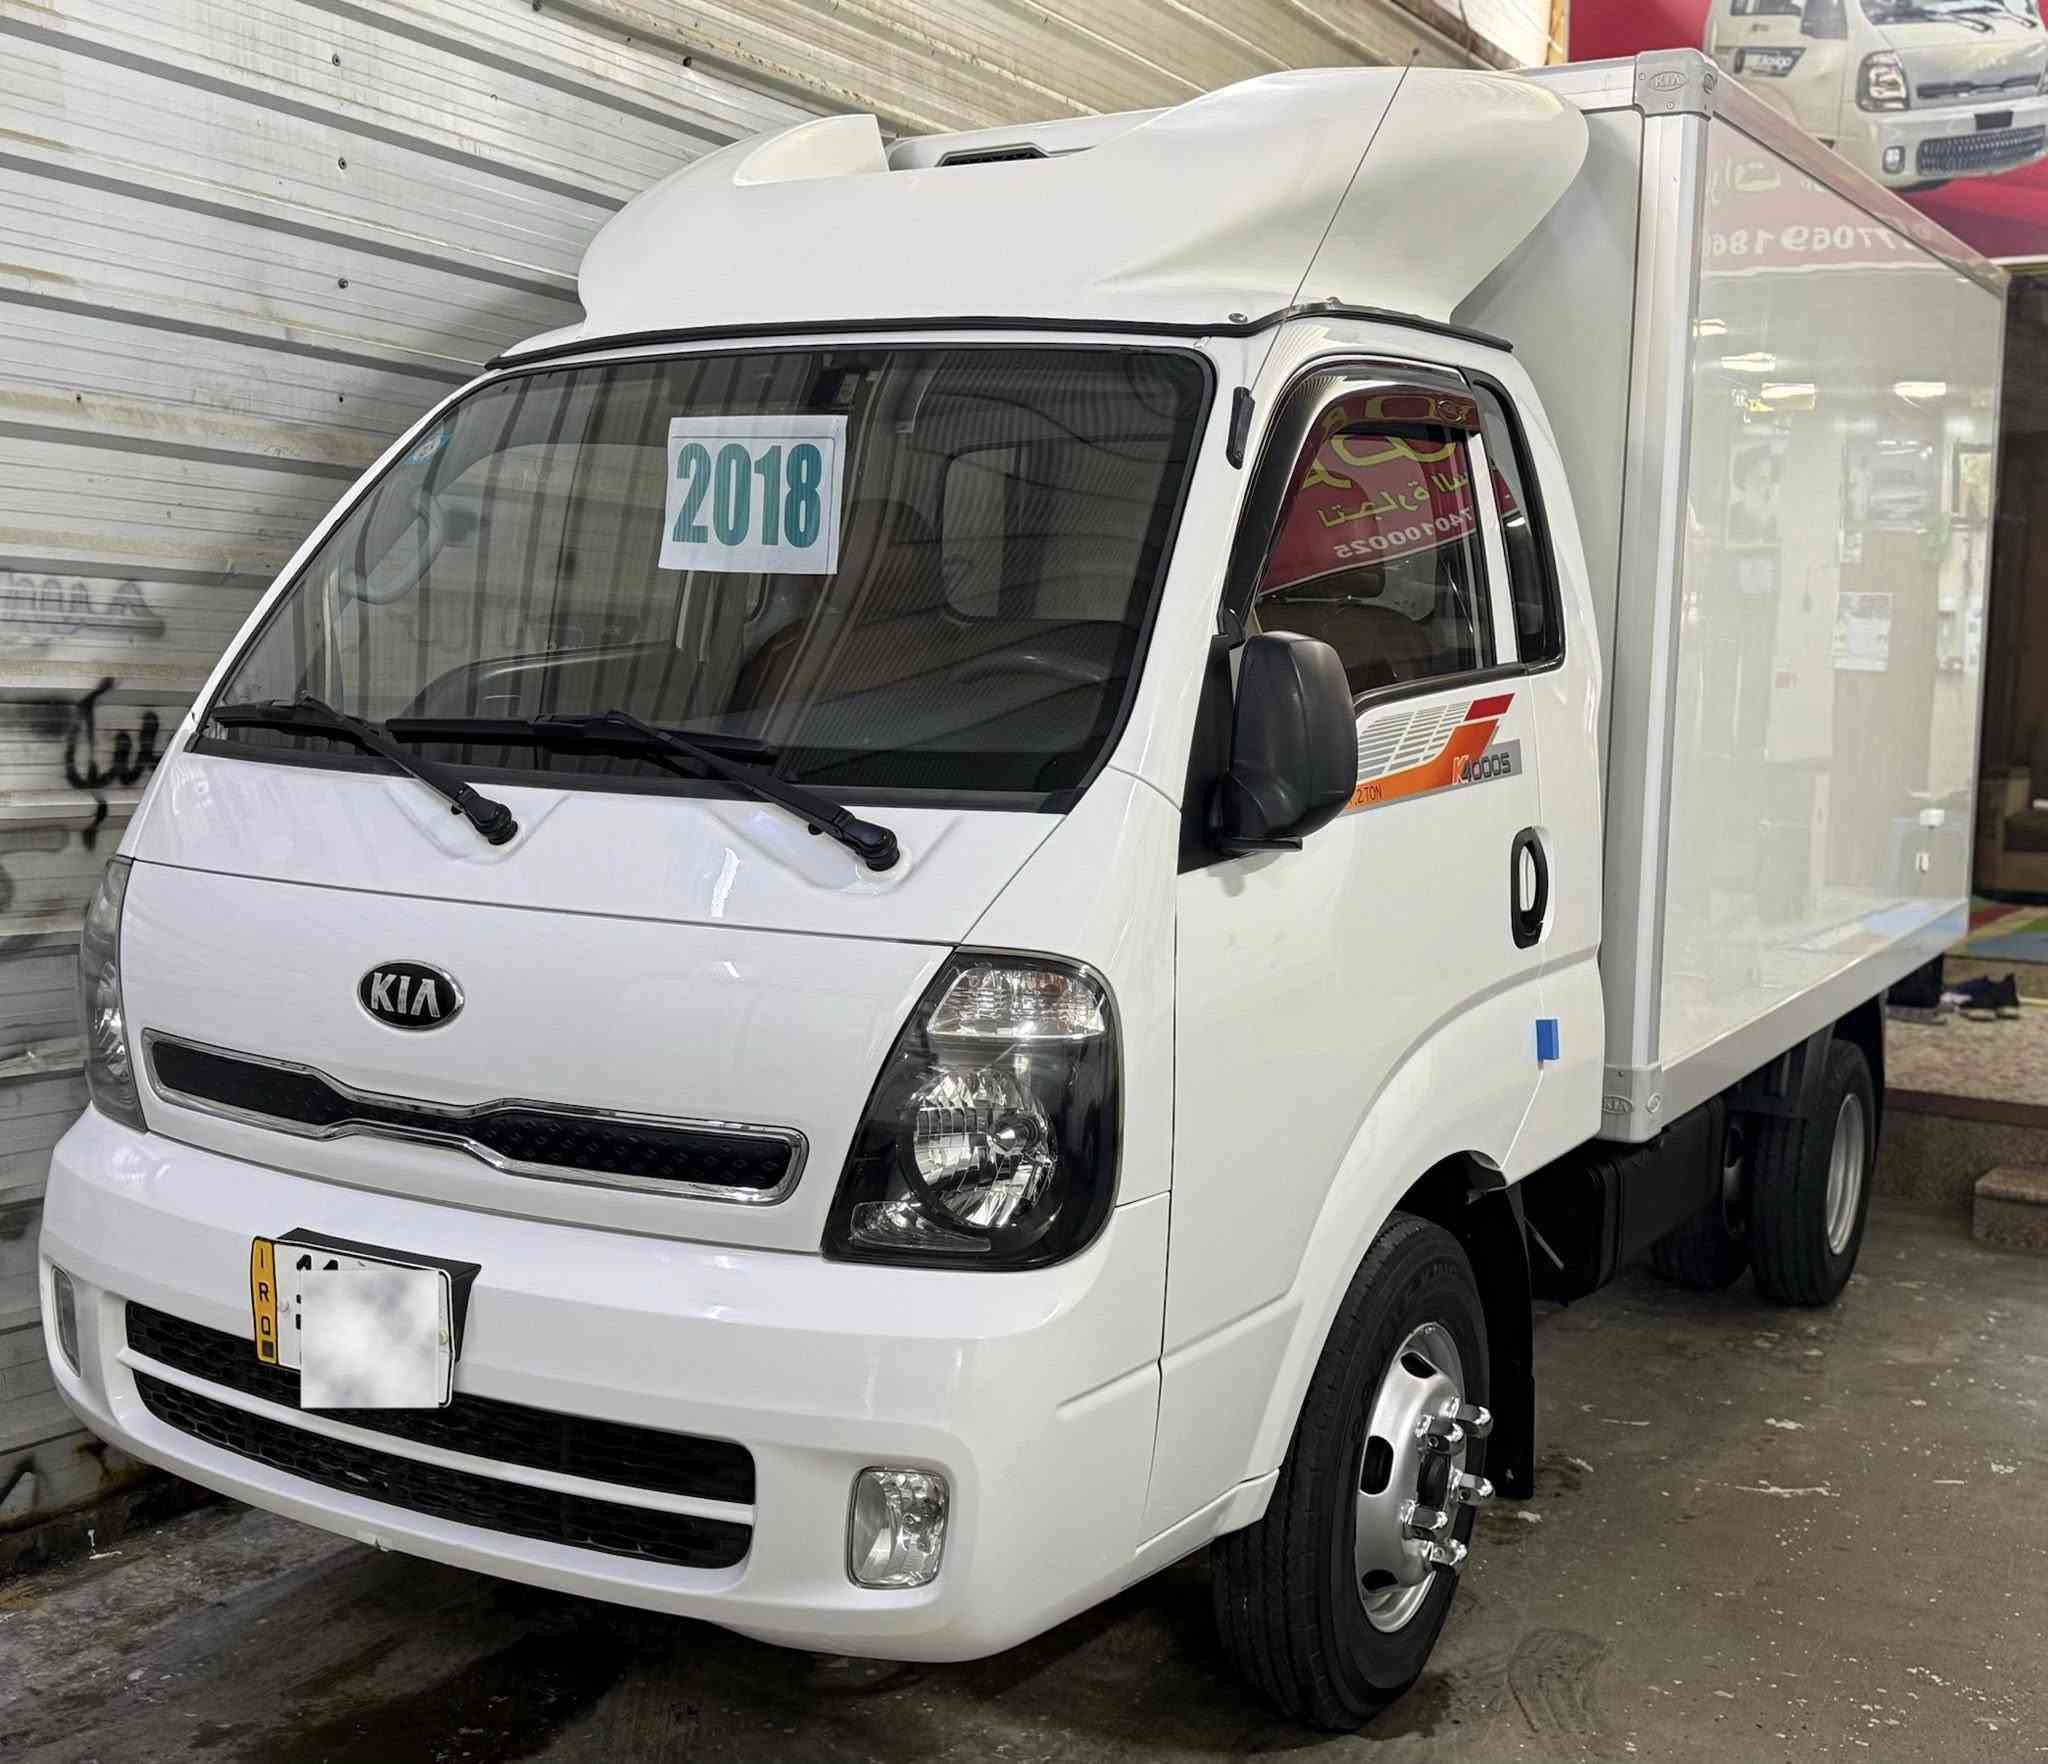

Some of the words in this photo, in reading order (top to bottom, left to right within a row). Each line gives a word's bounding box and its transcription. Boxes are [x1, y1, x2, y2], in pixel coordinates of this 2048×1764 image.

[672, 443, 822, 548] 2018
[371, 971, 441, 1018] KIA
[258, 1248, 272, 1337] IRQ
